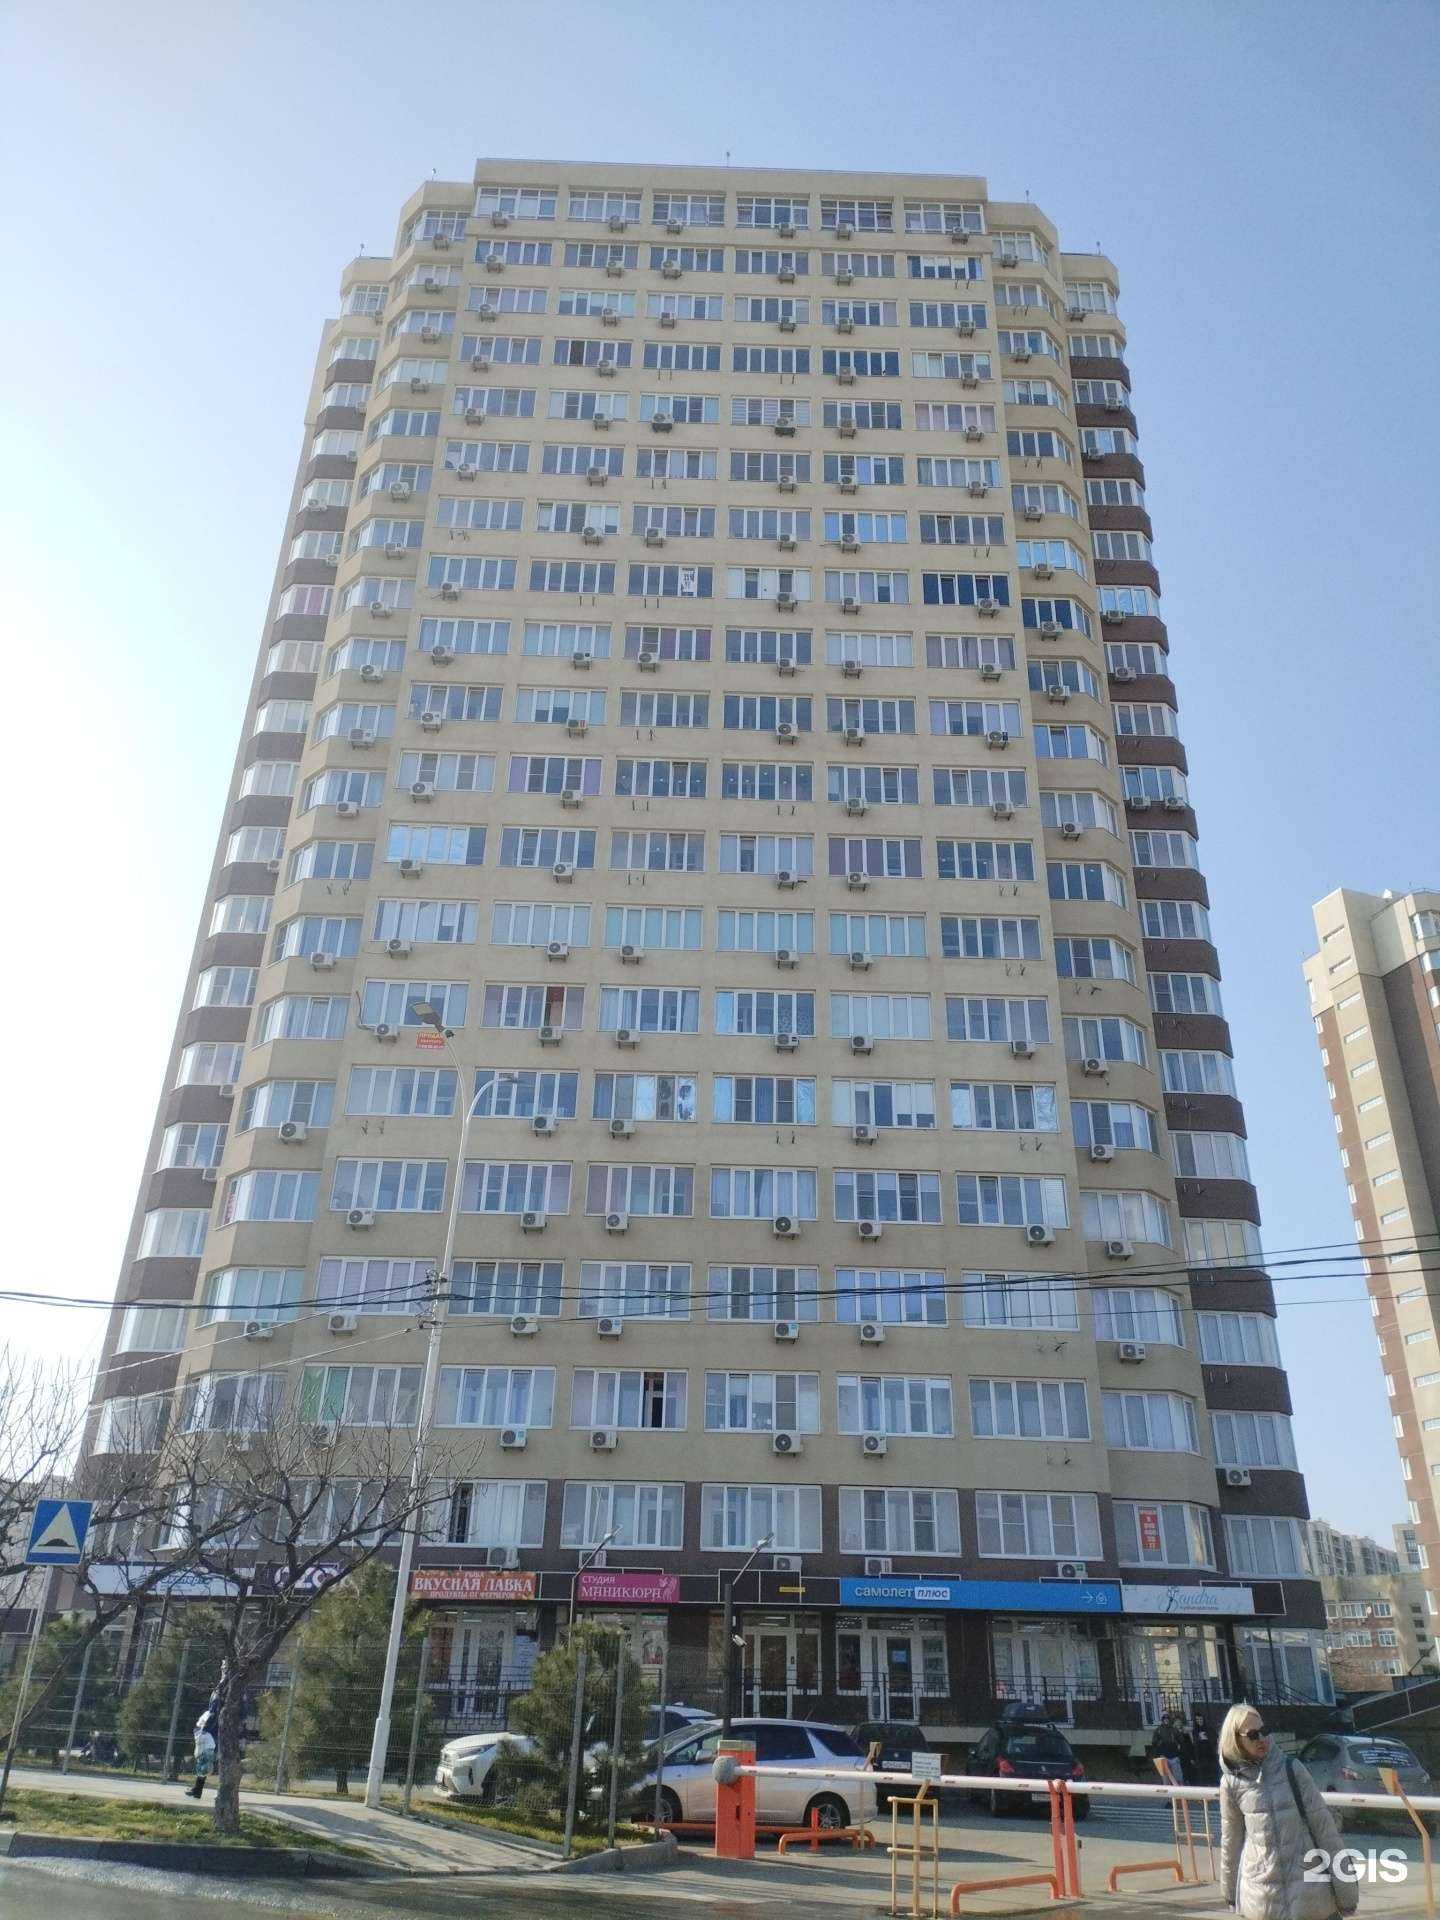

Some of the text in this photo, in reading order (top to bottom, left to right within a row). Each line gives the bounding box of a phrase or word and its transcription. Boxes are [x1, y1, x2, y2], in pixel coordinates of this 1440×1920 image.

[414, 1577, 533, 1592] ВКУСНАЯ ЛАВКА
[582, 1575, 616, 1585] СТУДИЯ
[582, 1586, 662, 1601] МАНИКЮРА
[855, 1587, 949, 1599] самолет плюс
